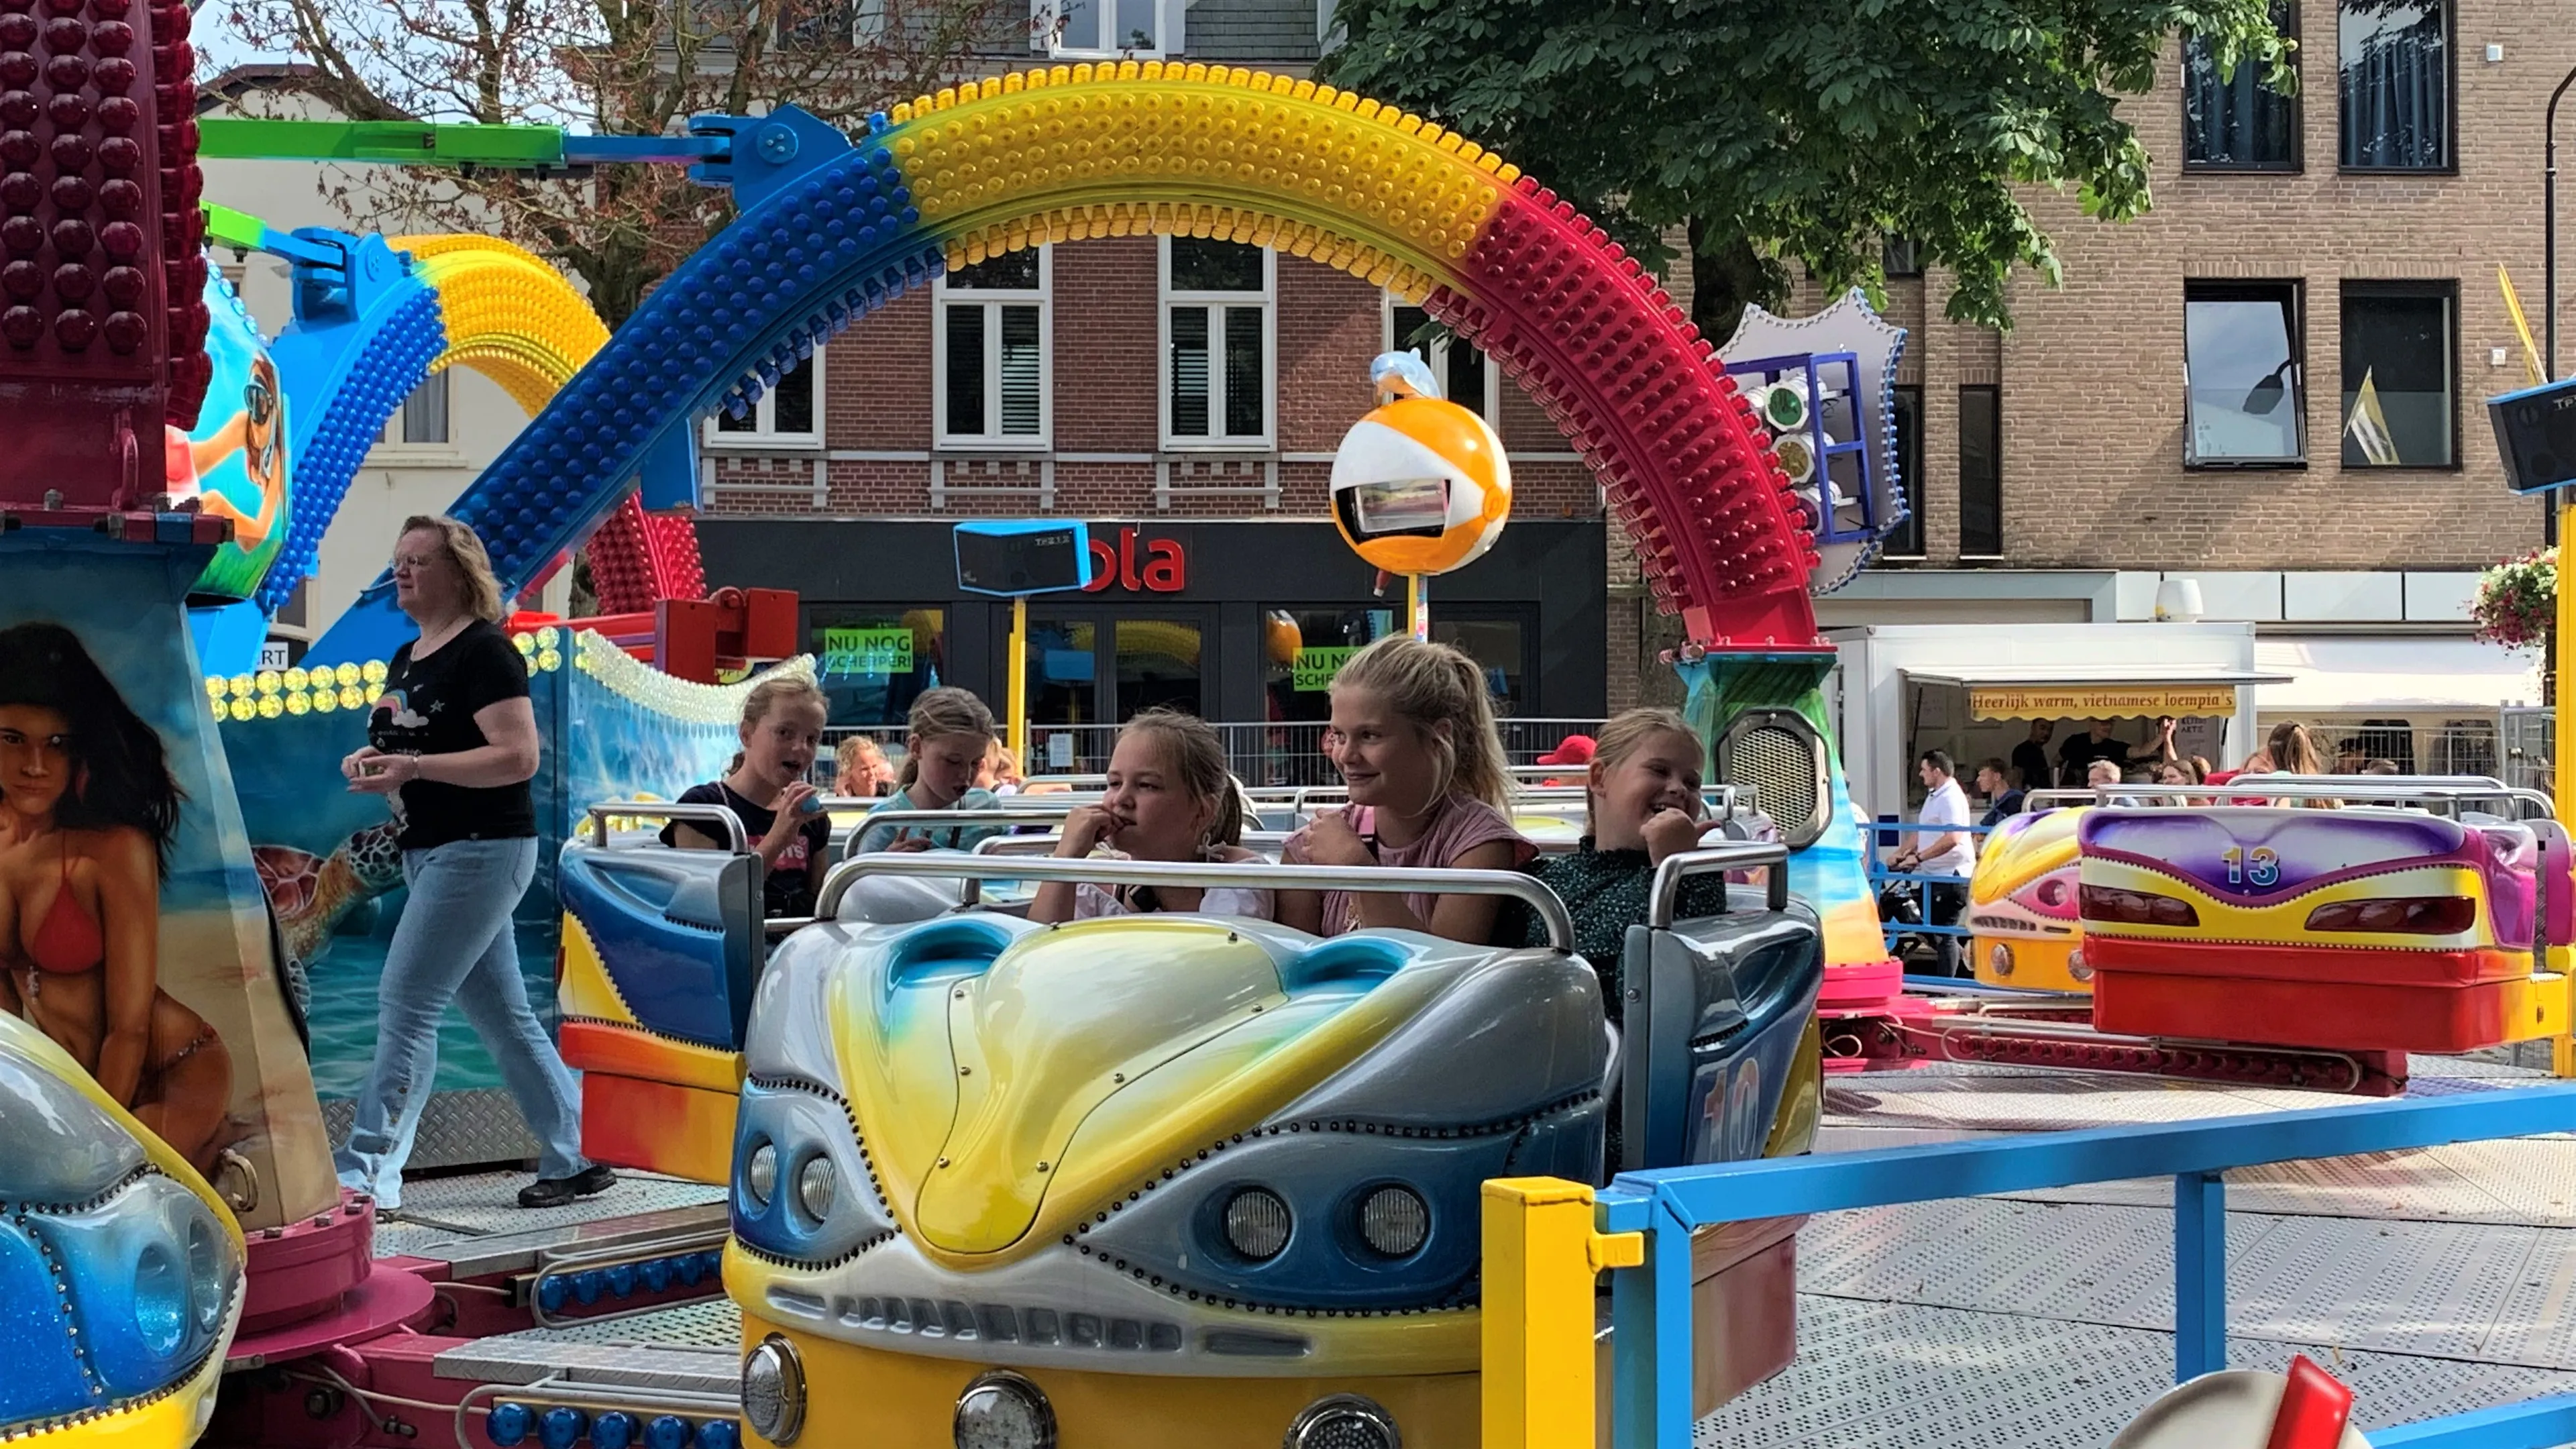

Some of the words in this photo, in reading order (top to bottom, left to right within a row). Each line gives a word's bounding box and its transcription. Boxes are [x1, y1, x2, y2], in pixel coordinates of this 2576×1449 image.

[828, 636, 857, 652] NU
[865, 636, 910, 652] NOG
[1296, 653, 1324, 669] NU
[1331, 653, 1352, 669] N
[1972, 694, 2029, 711] Heerlijk
[2034, 697, 2078, 709] warm,
[2083, 694, 2160, 707] vietnamese
[2165, 692, 2233, 709] loempia's
[2221, 846, 2279, 885] 13
[1704, 1057, 1760, 1163] 10
